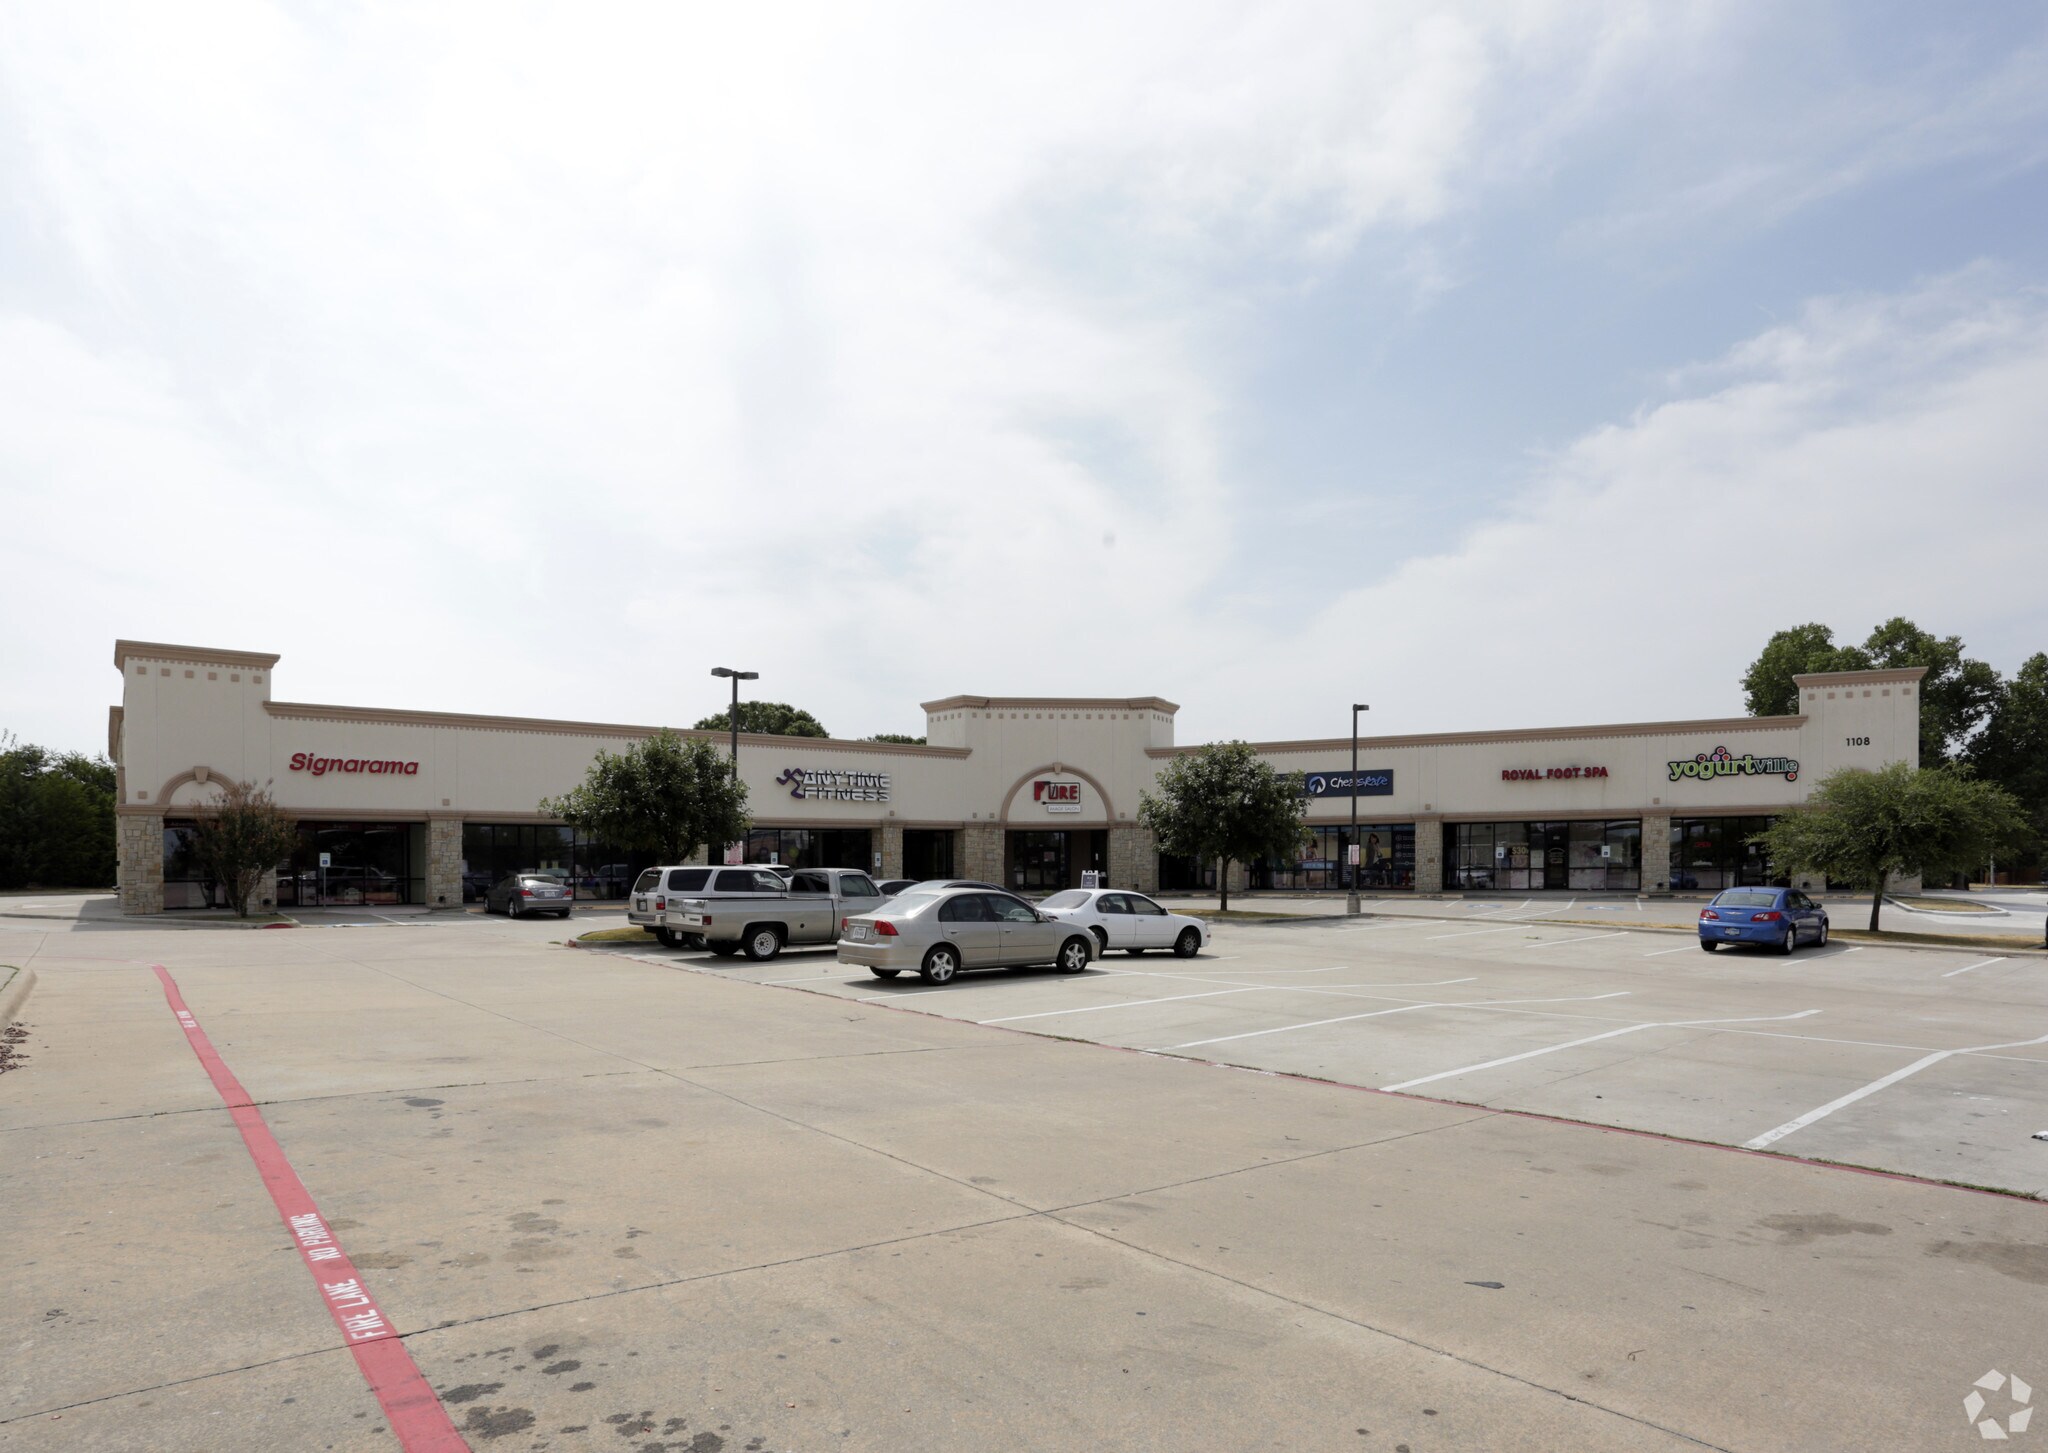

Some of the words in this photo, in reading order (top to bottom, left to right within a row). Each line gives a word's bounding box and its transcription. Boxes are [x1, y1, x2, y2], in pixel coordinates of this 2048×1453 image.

[1846, 737, 1870, 747] 1108
[289, 753, 419, 776] Signarama
[1502, 768, 1543, 781] ROYAL
[1546, 767, 1581, 779] FOOT
[1584, 766, 1608, 778] SPA
[802, 768, 891, 787] ANYTIME
[1330, 775, 1388, 789] Cheaskate
[803, 787, 891, 802] FITNESS
[1034, 781, 1078, 801] PURE
[289, 1213, 333, 1247] PARKING
[307, 1246, 342, 1262] NO
[323, 1278, 370, 1309] LANE
[341, 1309, 387, 1340] FIRE
